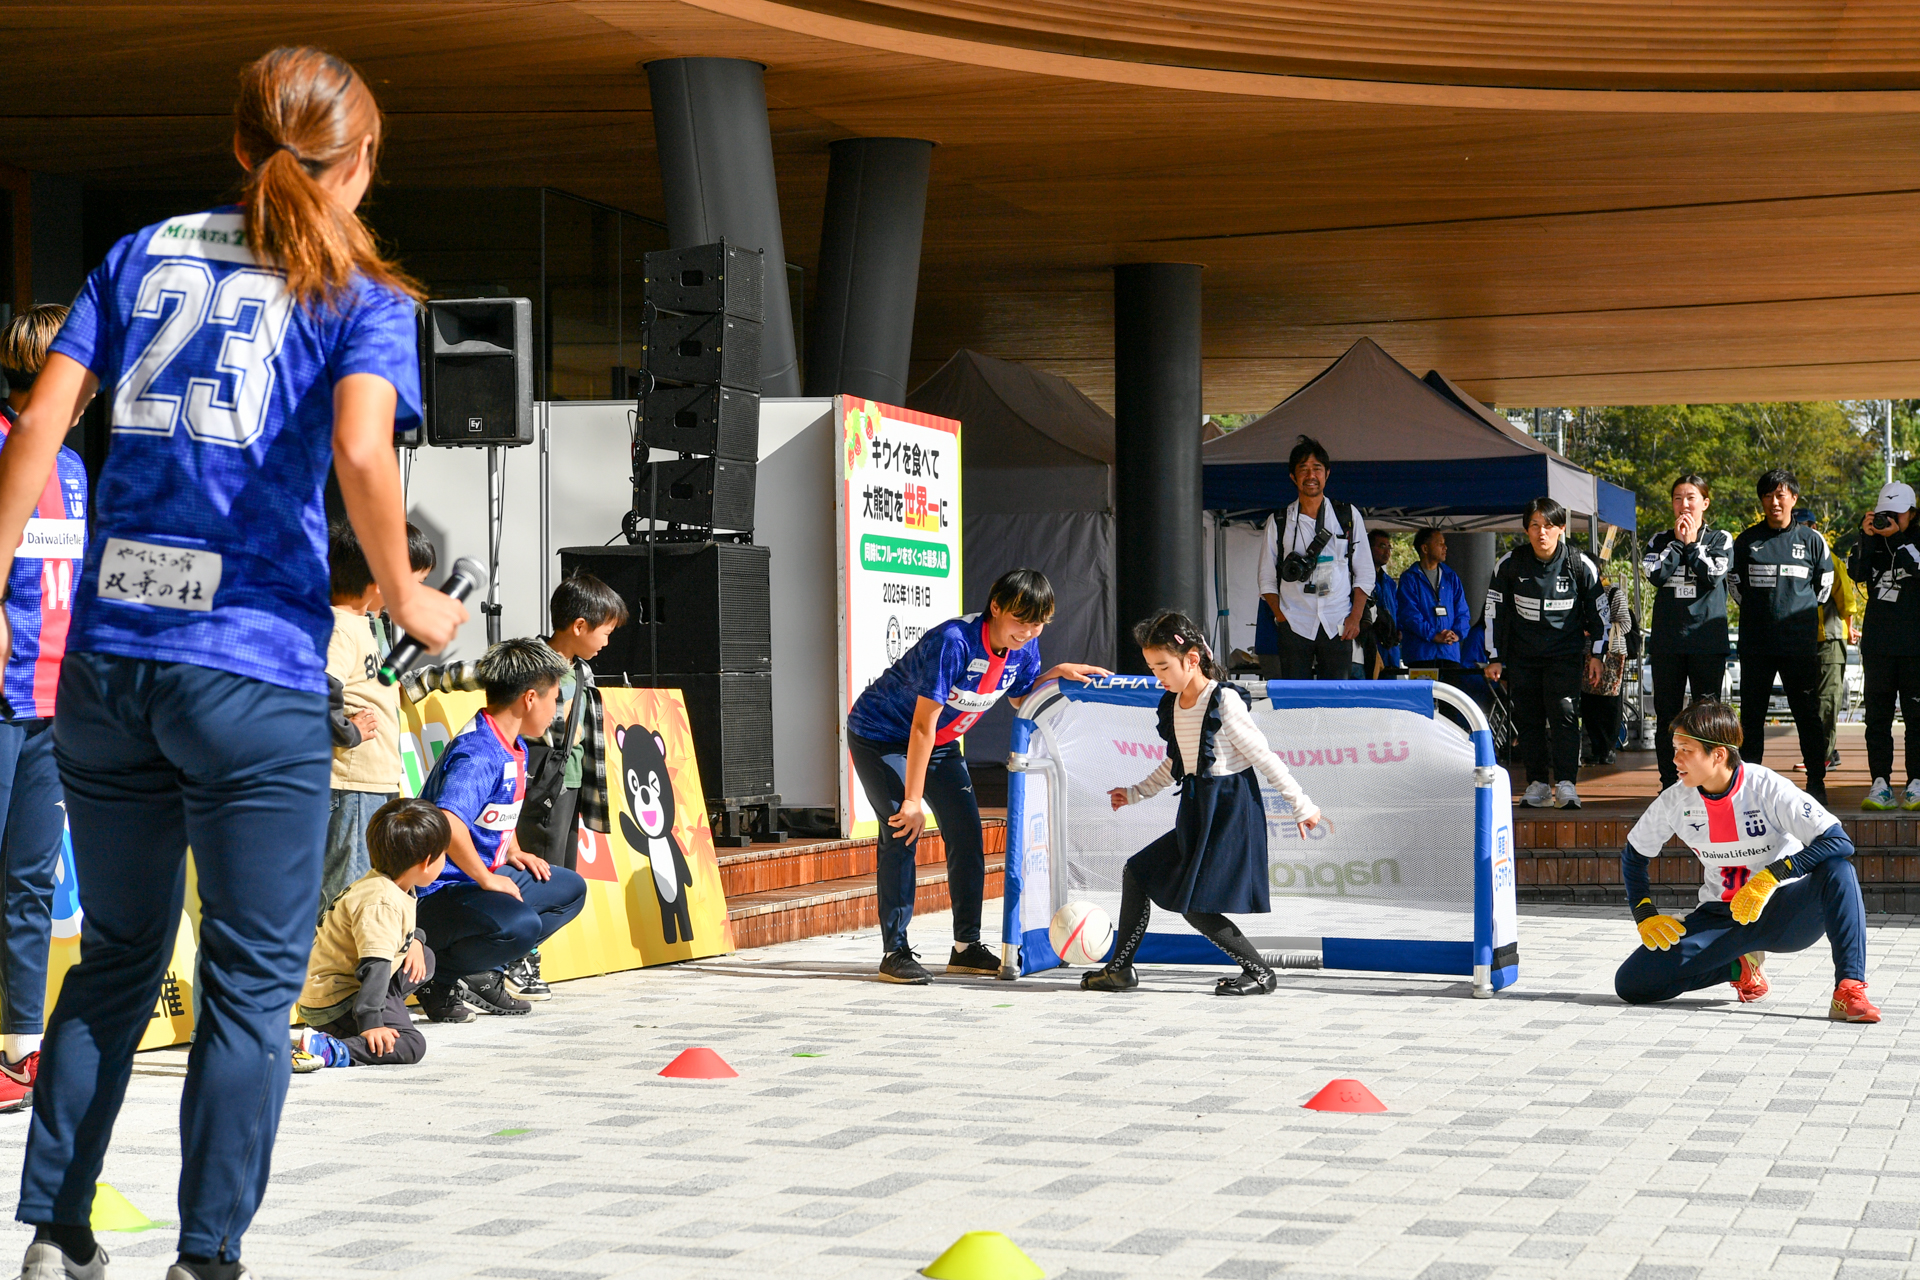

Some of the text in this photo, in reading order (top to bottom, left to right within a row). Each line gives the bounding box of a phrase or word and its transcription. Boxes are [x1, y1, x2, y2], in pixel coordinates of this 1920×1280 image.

[112, 259, 295, 449] 23
[872, 435, 940, 480] キウイを食べて
[863, 482, 948, 528] 大熊町を世界一に
[883, 582, 931, 608] 2025年11月1日
[1678, 587, 1694, 596] 164
[904, 626, 929, 641] OFFICI
[1083, 677, 1149, 689] ALPHA
